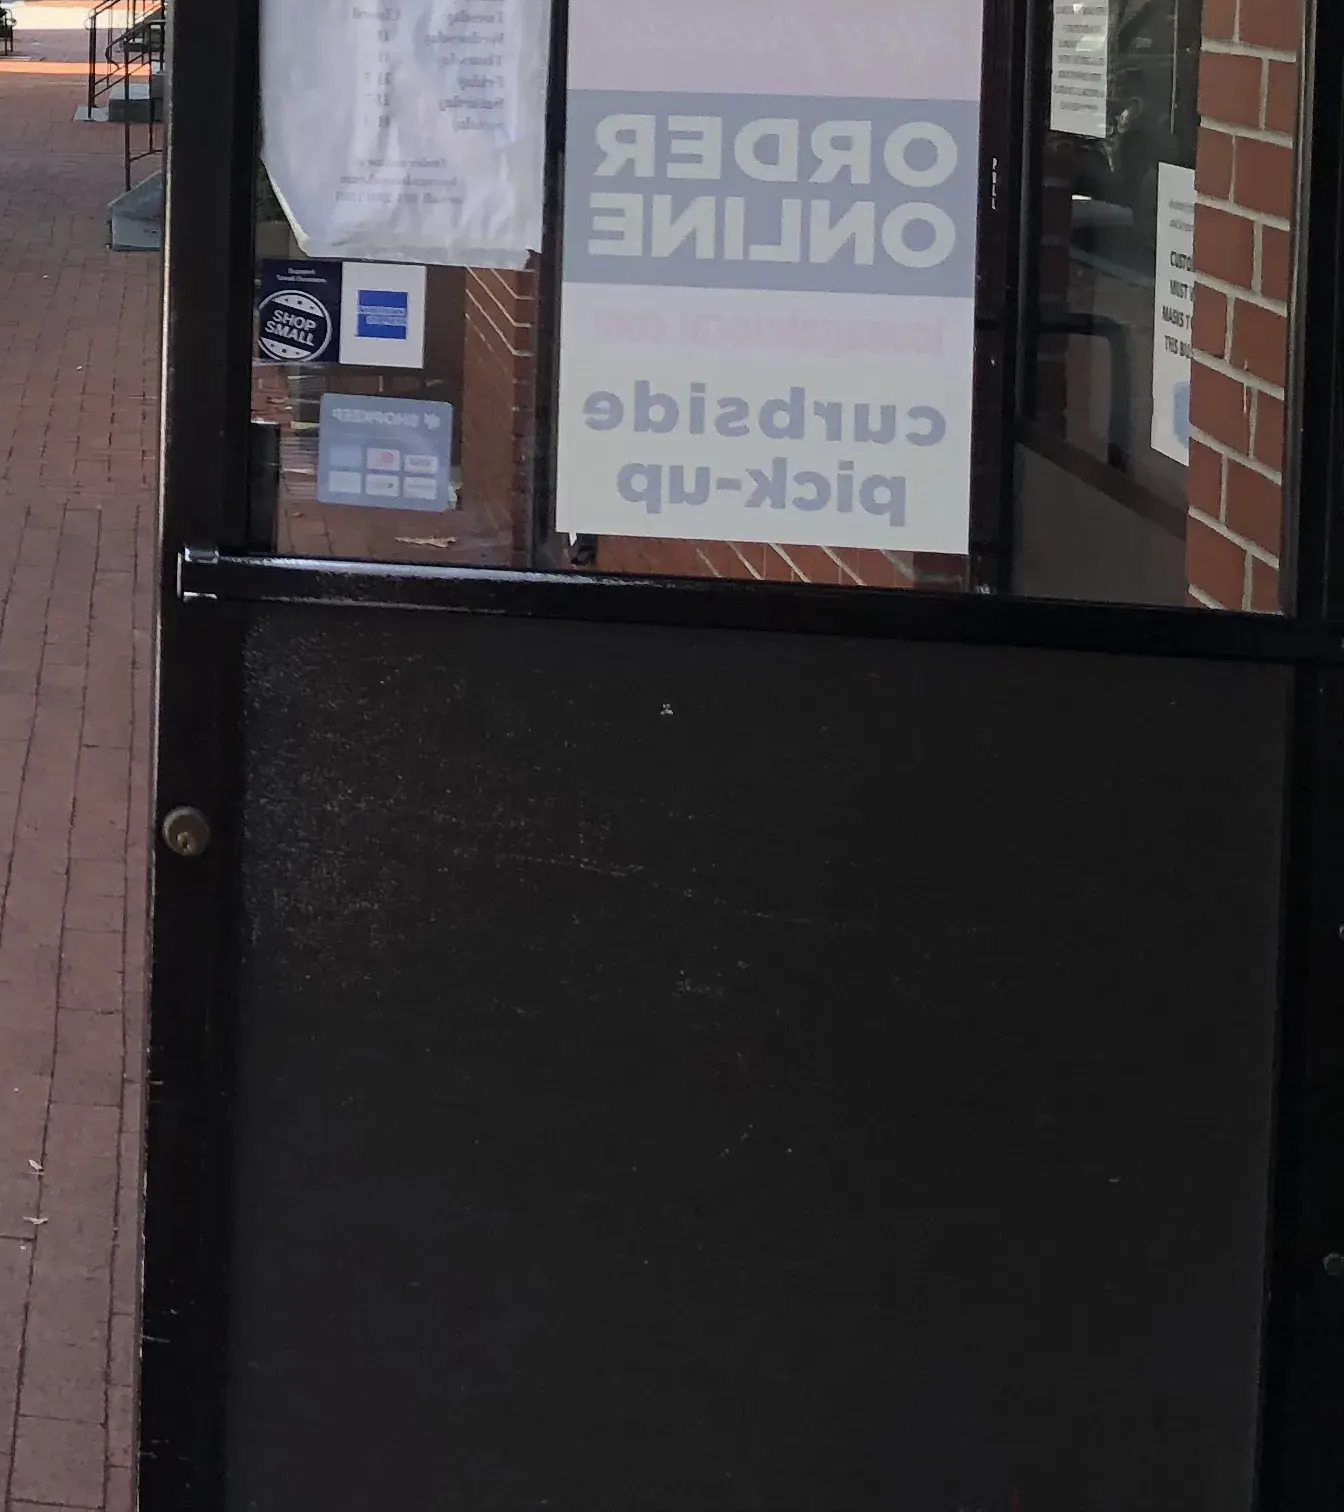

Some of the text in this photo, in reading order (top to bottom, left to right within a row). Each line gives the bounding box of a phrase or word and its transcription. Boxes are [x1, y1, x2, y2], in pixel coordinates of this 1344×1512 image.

[1169, 250, 1195, 273] CUSTO
[271, 309, 318, 332] SHOP
[264, 320, 315, 347] SMALL
